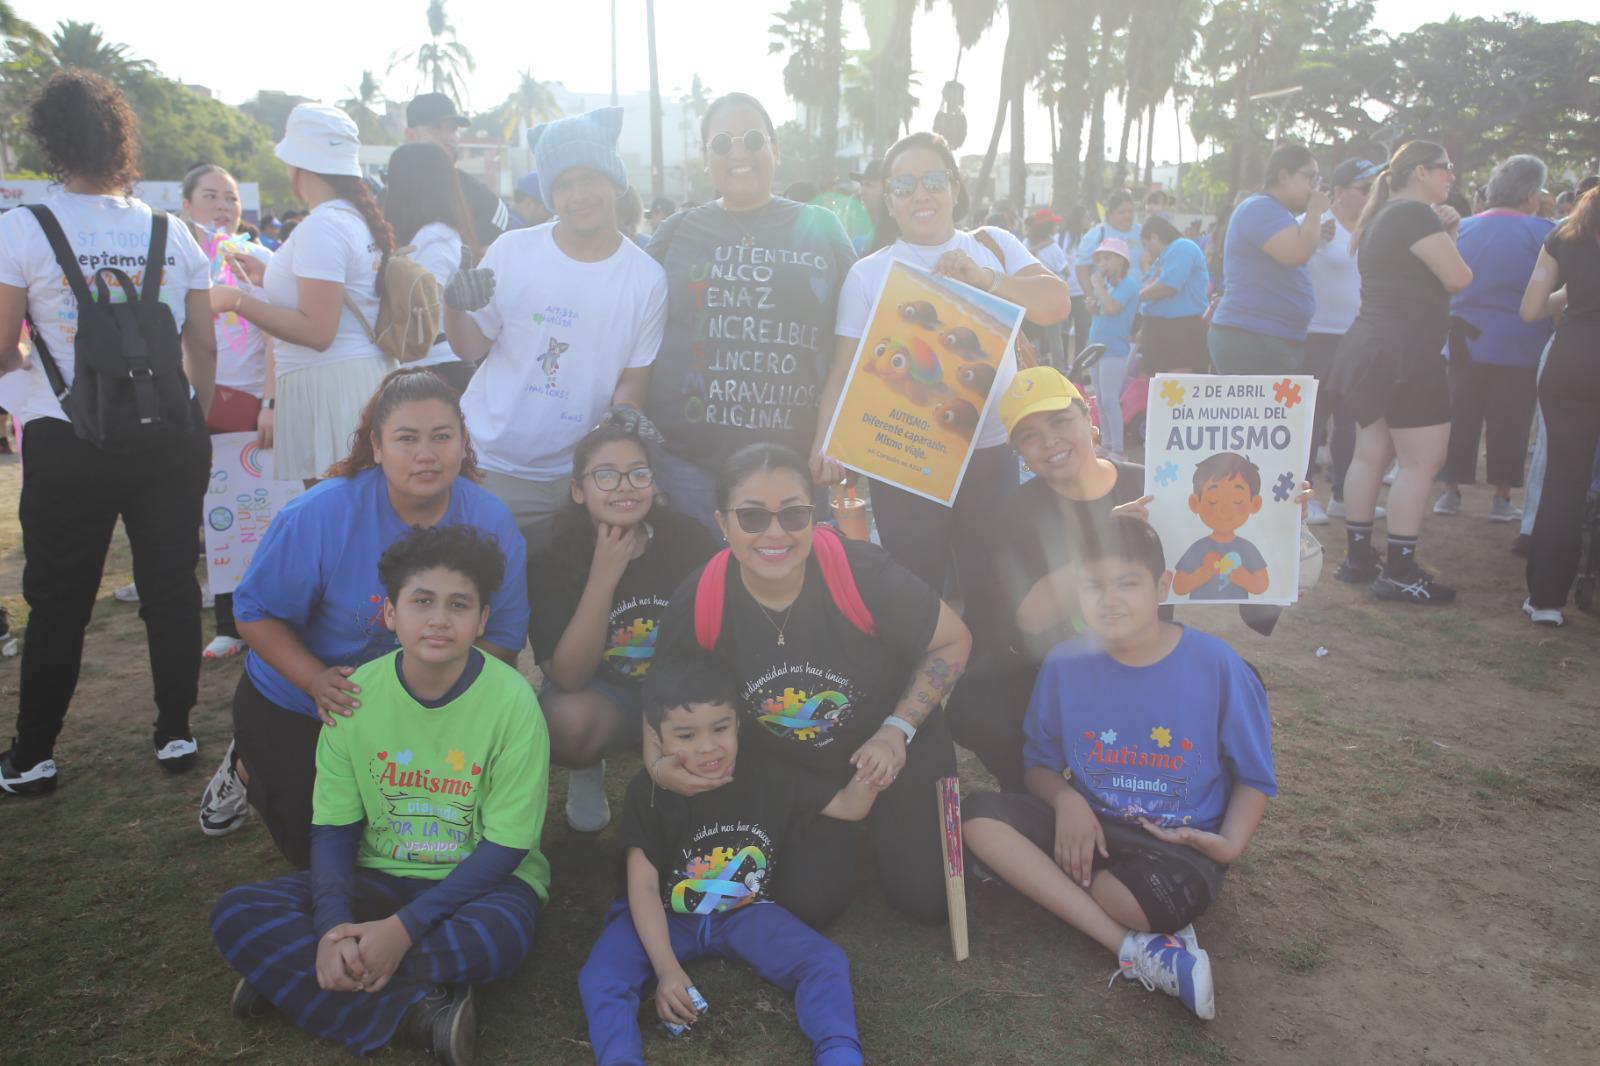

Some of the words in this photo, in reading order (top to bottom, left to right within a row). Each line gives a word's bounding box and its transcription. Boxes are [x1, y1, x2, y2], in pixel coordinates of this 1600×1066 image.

[1191, 385, 1200, 398] 2
[1205, 385, 1221, 398] DE
[1227, 384, 1265, 398] ABRIL
[1173, 404, 1193, 420] DÍA
[1199, 407, 1259, 420] MUNDIAL
[1265, 407, 1287, 420] DEL
[862, 412, 903, 436] Diferente
[875, 432, 902, 450] Mismo
[1166, 426, 1291, 450] AUTISMO
[748, 662, 787, 694] diversidad
[790, 664, 804, 674] nos
[806, 662, 823, 677] hace
[1087, 740, 1185, 772] Autismo
[380, 762, 472, 797] Autismo
[1113, 776, 1167, 792] viajando
[422, 821, 438, 837] LA
[720, 823, 735, 833] nos
